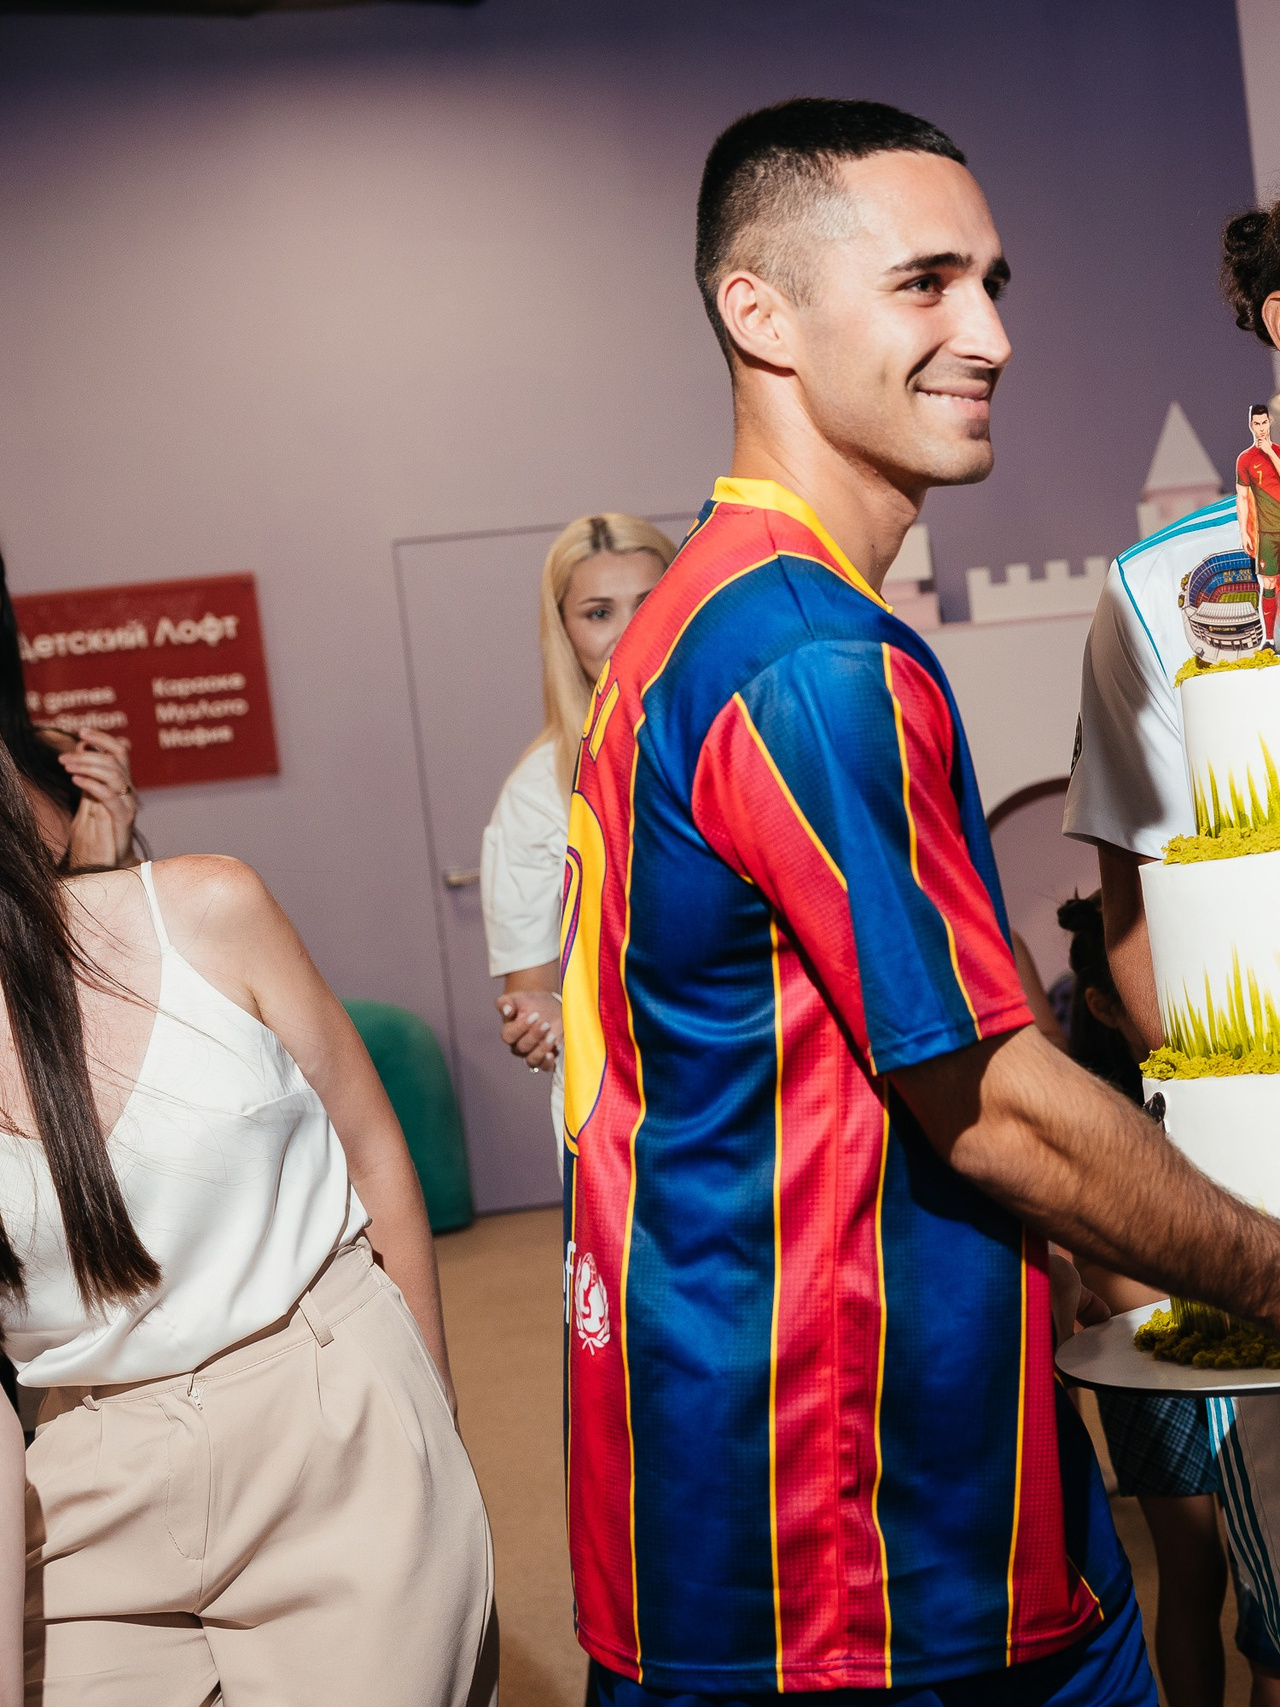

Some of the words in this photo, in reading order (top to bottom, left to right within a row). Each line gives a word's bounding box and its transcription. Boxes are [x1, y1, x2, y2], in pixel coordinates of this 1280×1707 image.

[1256, 470, 1263, 485] 7
[154, 613, 239, 646] Лофт
[153, 673, 246, 698] Караоке
[44, 687, 116, 713] games
[159, 725, 233, 749] Мафия
